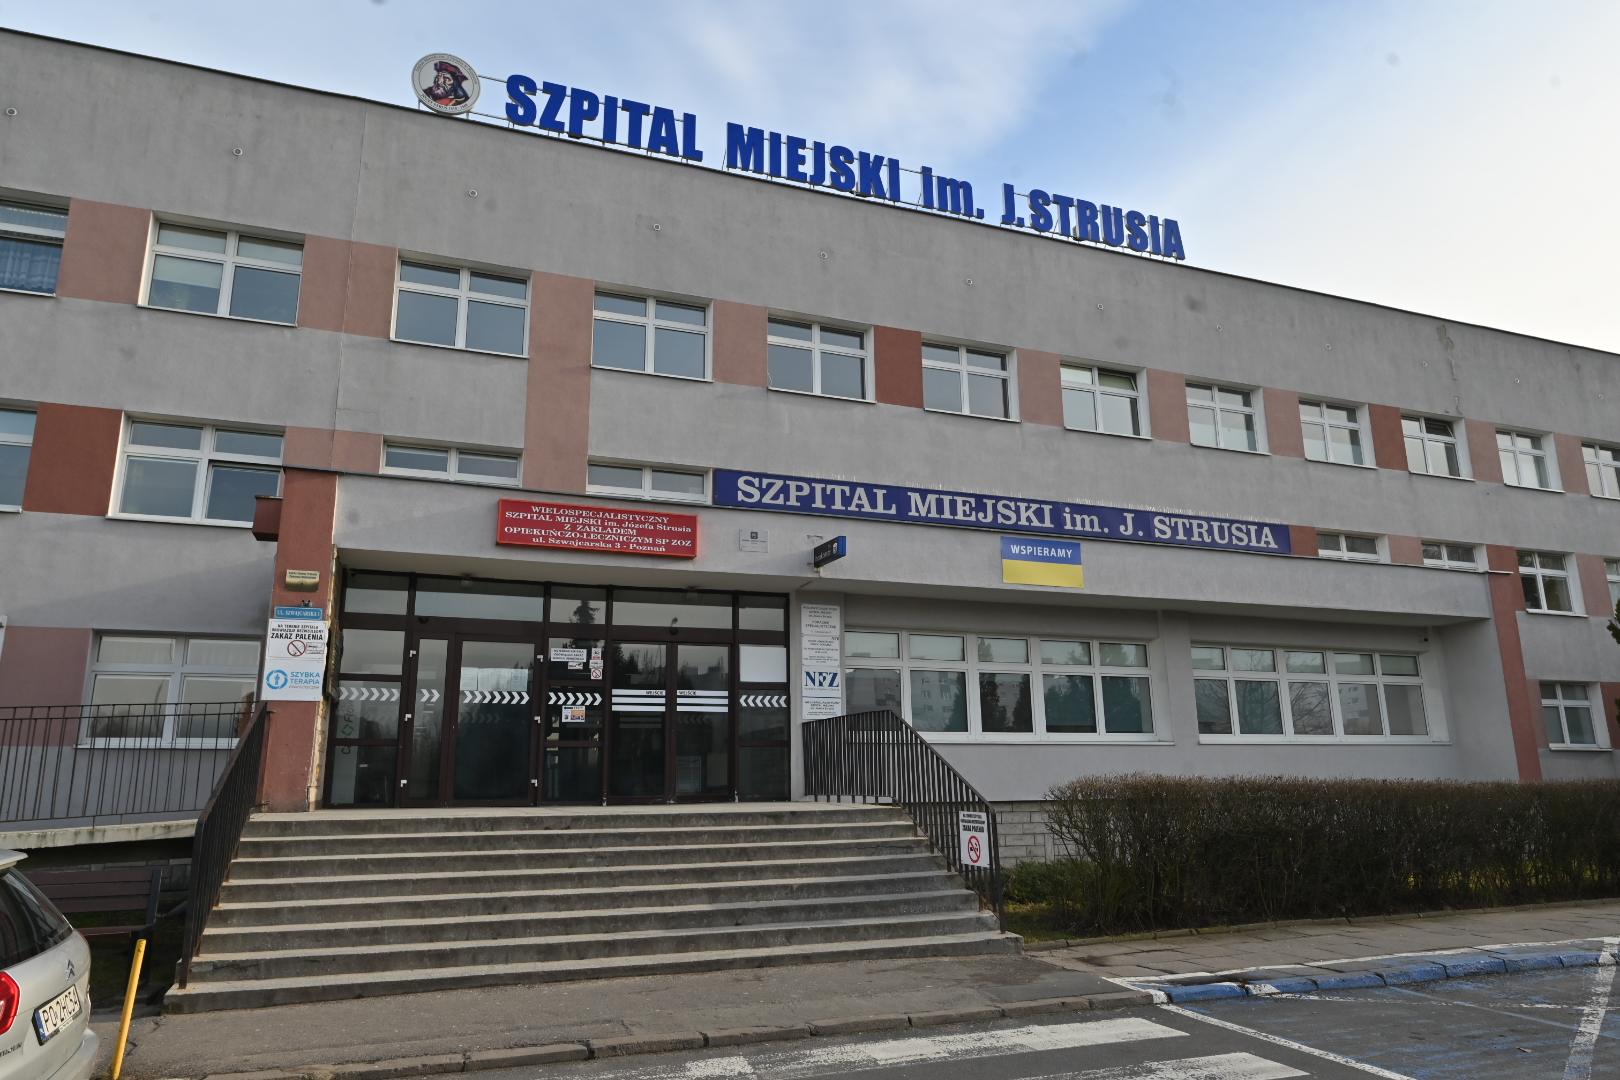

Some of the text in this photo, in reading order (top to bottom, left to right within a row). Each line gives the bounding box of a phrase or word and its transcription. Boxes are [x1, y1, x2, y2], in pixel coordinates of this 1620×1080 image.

[505, 74, 1186, 260] SZPITAL MIEJSKI im. J.STRUSIA
[505, 511, 692, 532] SZPITAL MIEJSKI im. Józefa Strusia
[531, 506, 670, 524] WIELOSPECJALISTYCZNY
[737, 475, 1279, 549] SZPITAL MIEJSKI im. J. STRUSIA
[504, 526, 653, 545] OPIEKUŃCZO-LECZNICZYM
[671, 539, 692, 547] ZOZ
[548, 537, 612, 548] Szwajcarska
[629, 542, 666, 552] Poznań
[1010, 544, 1073, 559] WSPIERAMY
[804, 671, 839, 687] NFZ
[42, 1006, 57, 1032] PO
